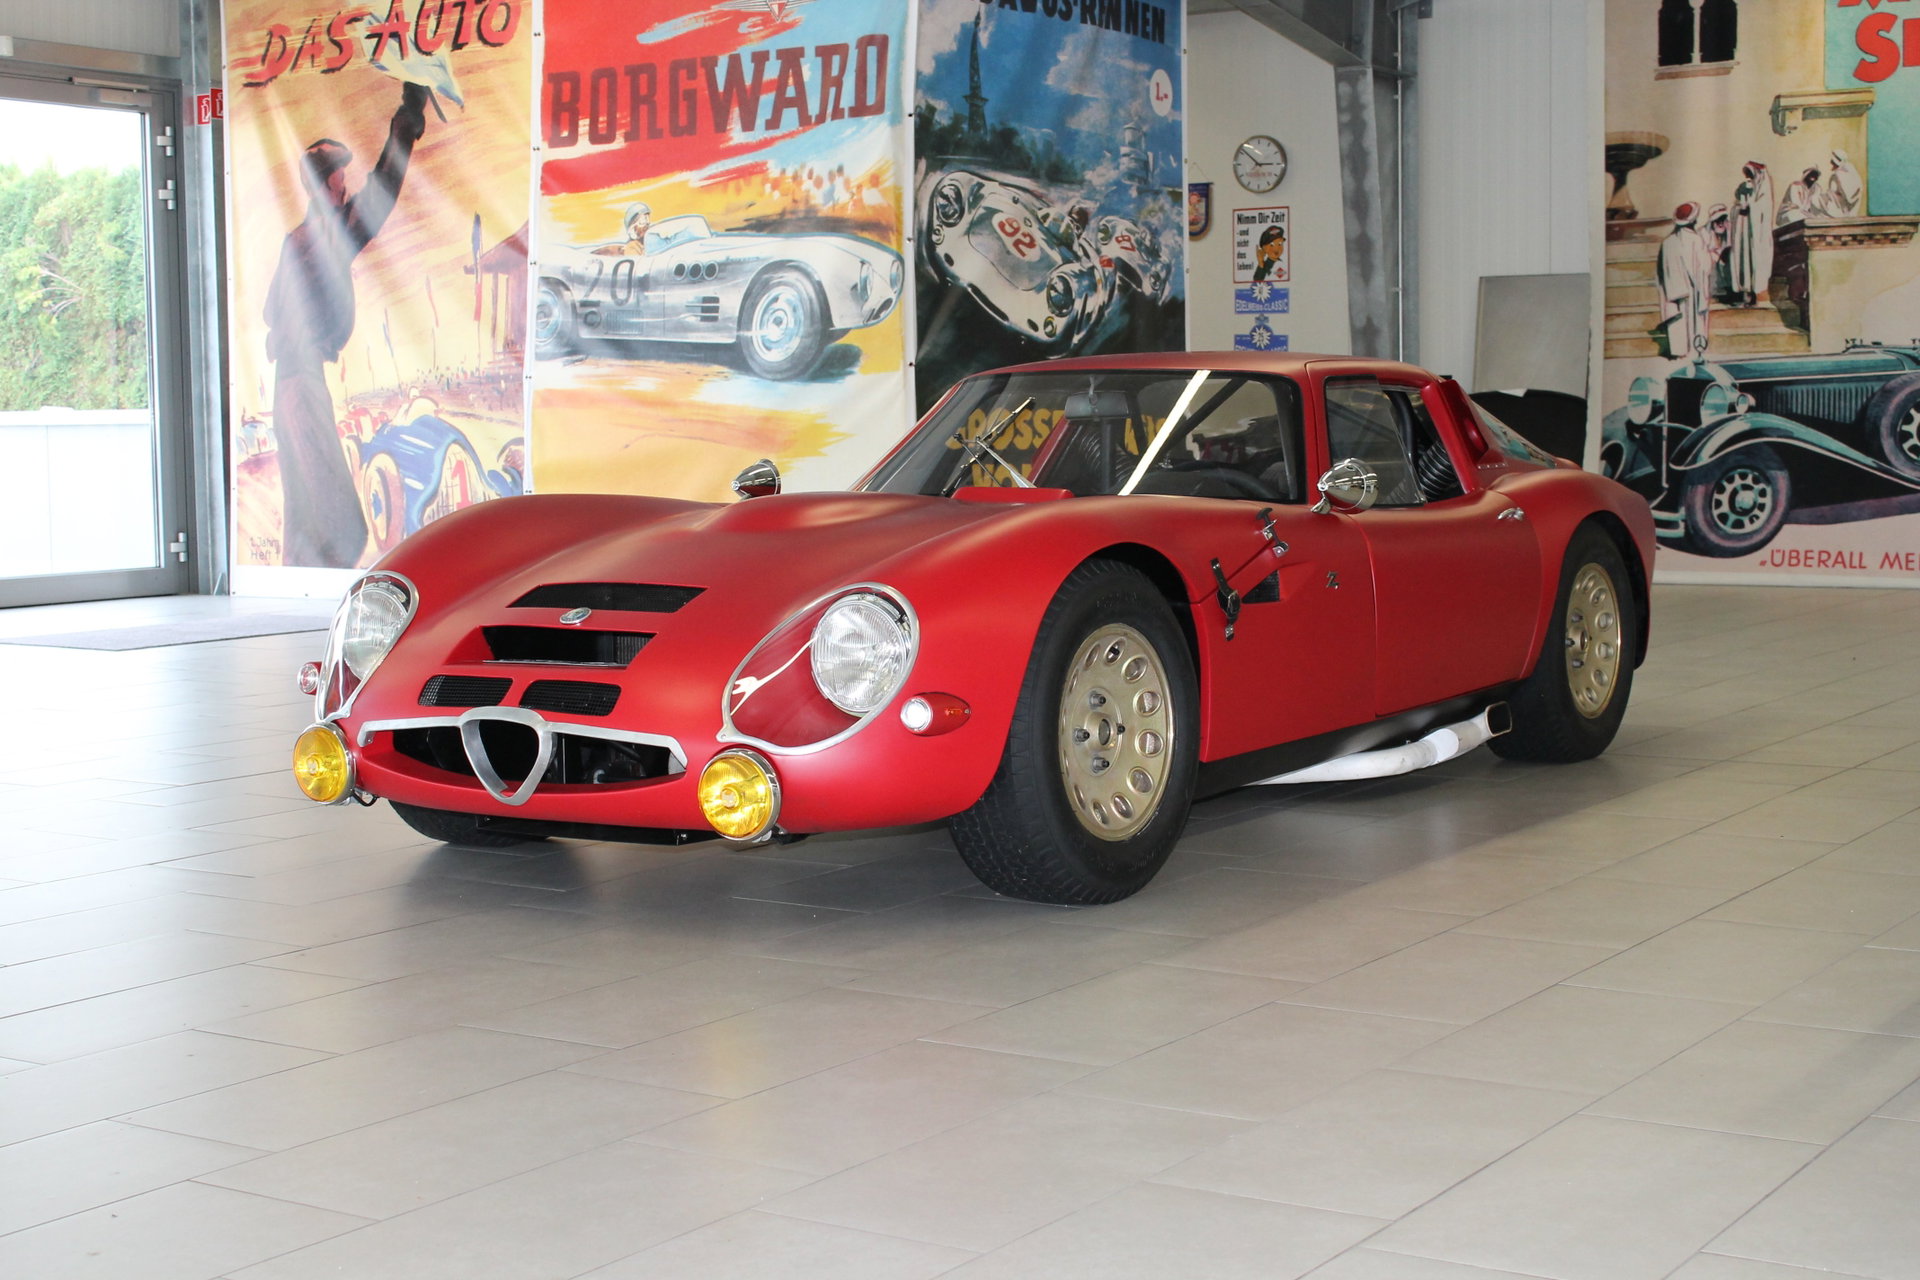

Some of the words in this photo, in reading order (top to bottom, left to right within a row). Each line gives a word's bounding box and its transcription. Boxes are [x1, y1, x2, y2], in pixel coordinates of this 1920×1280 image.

[243, 11, 373, 87] DAS
[364, 0, 522, 60] AUTO
[547, 34, 889, 148] BORGWARD
[998, 217, 1036, 258] 92
[1236, 213, 1257, 225] Nimm
[1258, 212, 1270, 224] Dir
[1271, 211, 1286, 223] Zeit
[579, 258, 636, 307] 20
[1880, 552, 1920, 571] ME
